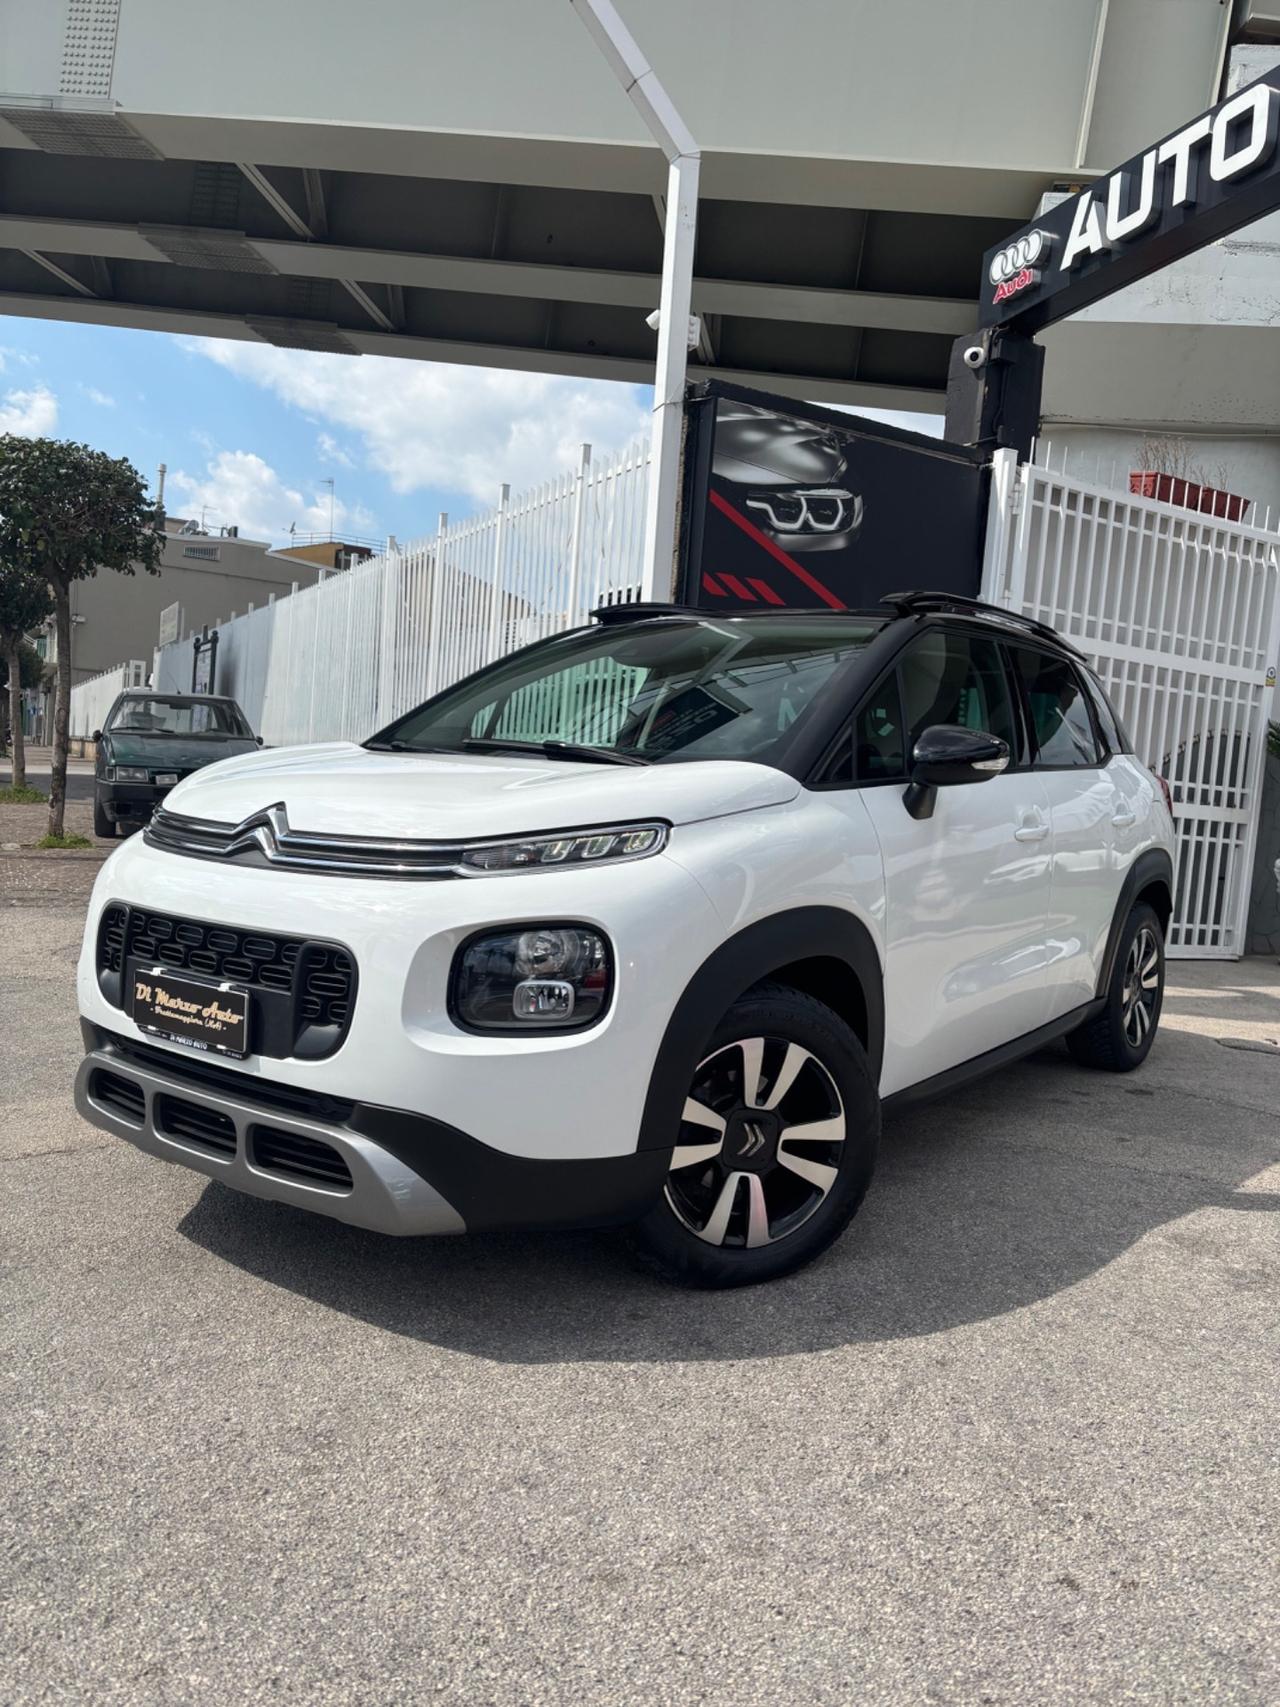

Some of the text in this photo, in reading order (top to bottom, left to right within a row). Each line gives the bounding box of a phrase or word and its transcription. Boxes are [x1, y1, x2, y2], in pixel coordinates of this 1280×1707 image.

[1059, 83, 1270, 272] AUTO
[992, 267, 1034, 305] Audi
[155, 988, 202, 1013] Marzo
[202, 1001, 244, 1024] Auto
